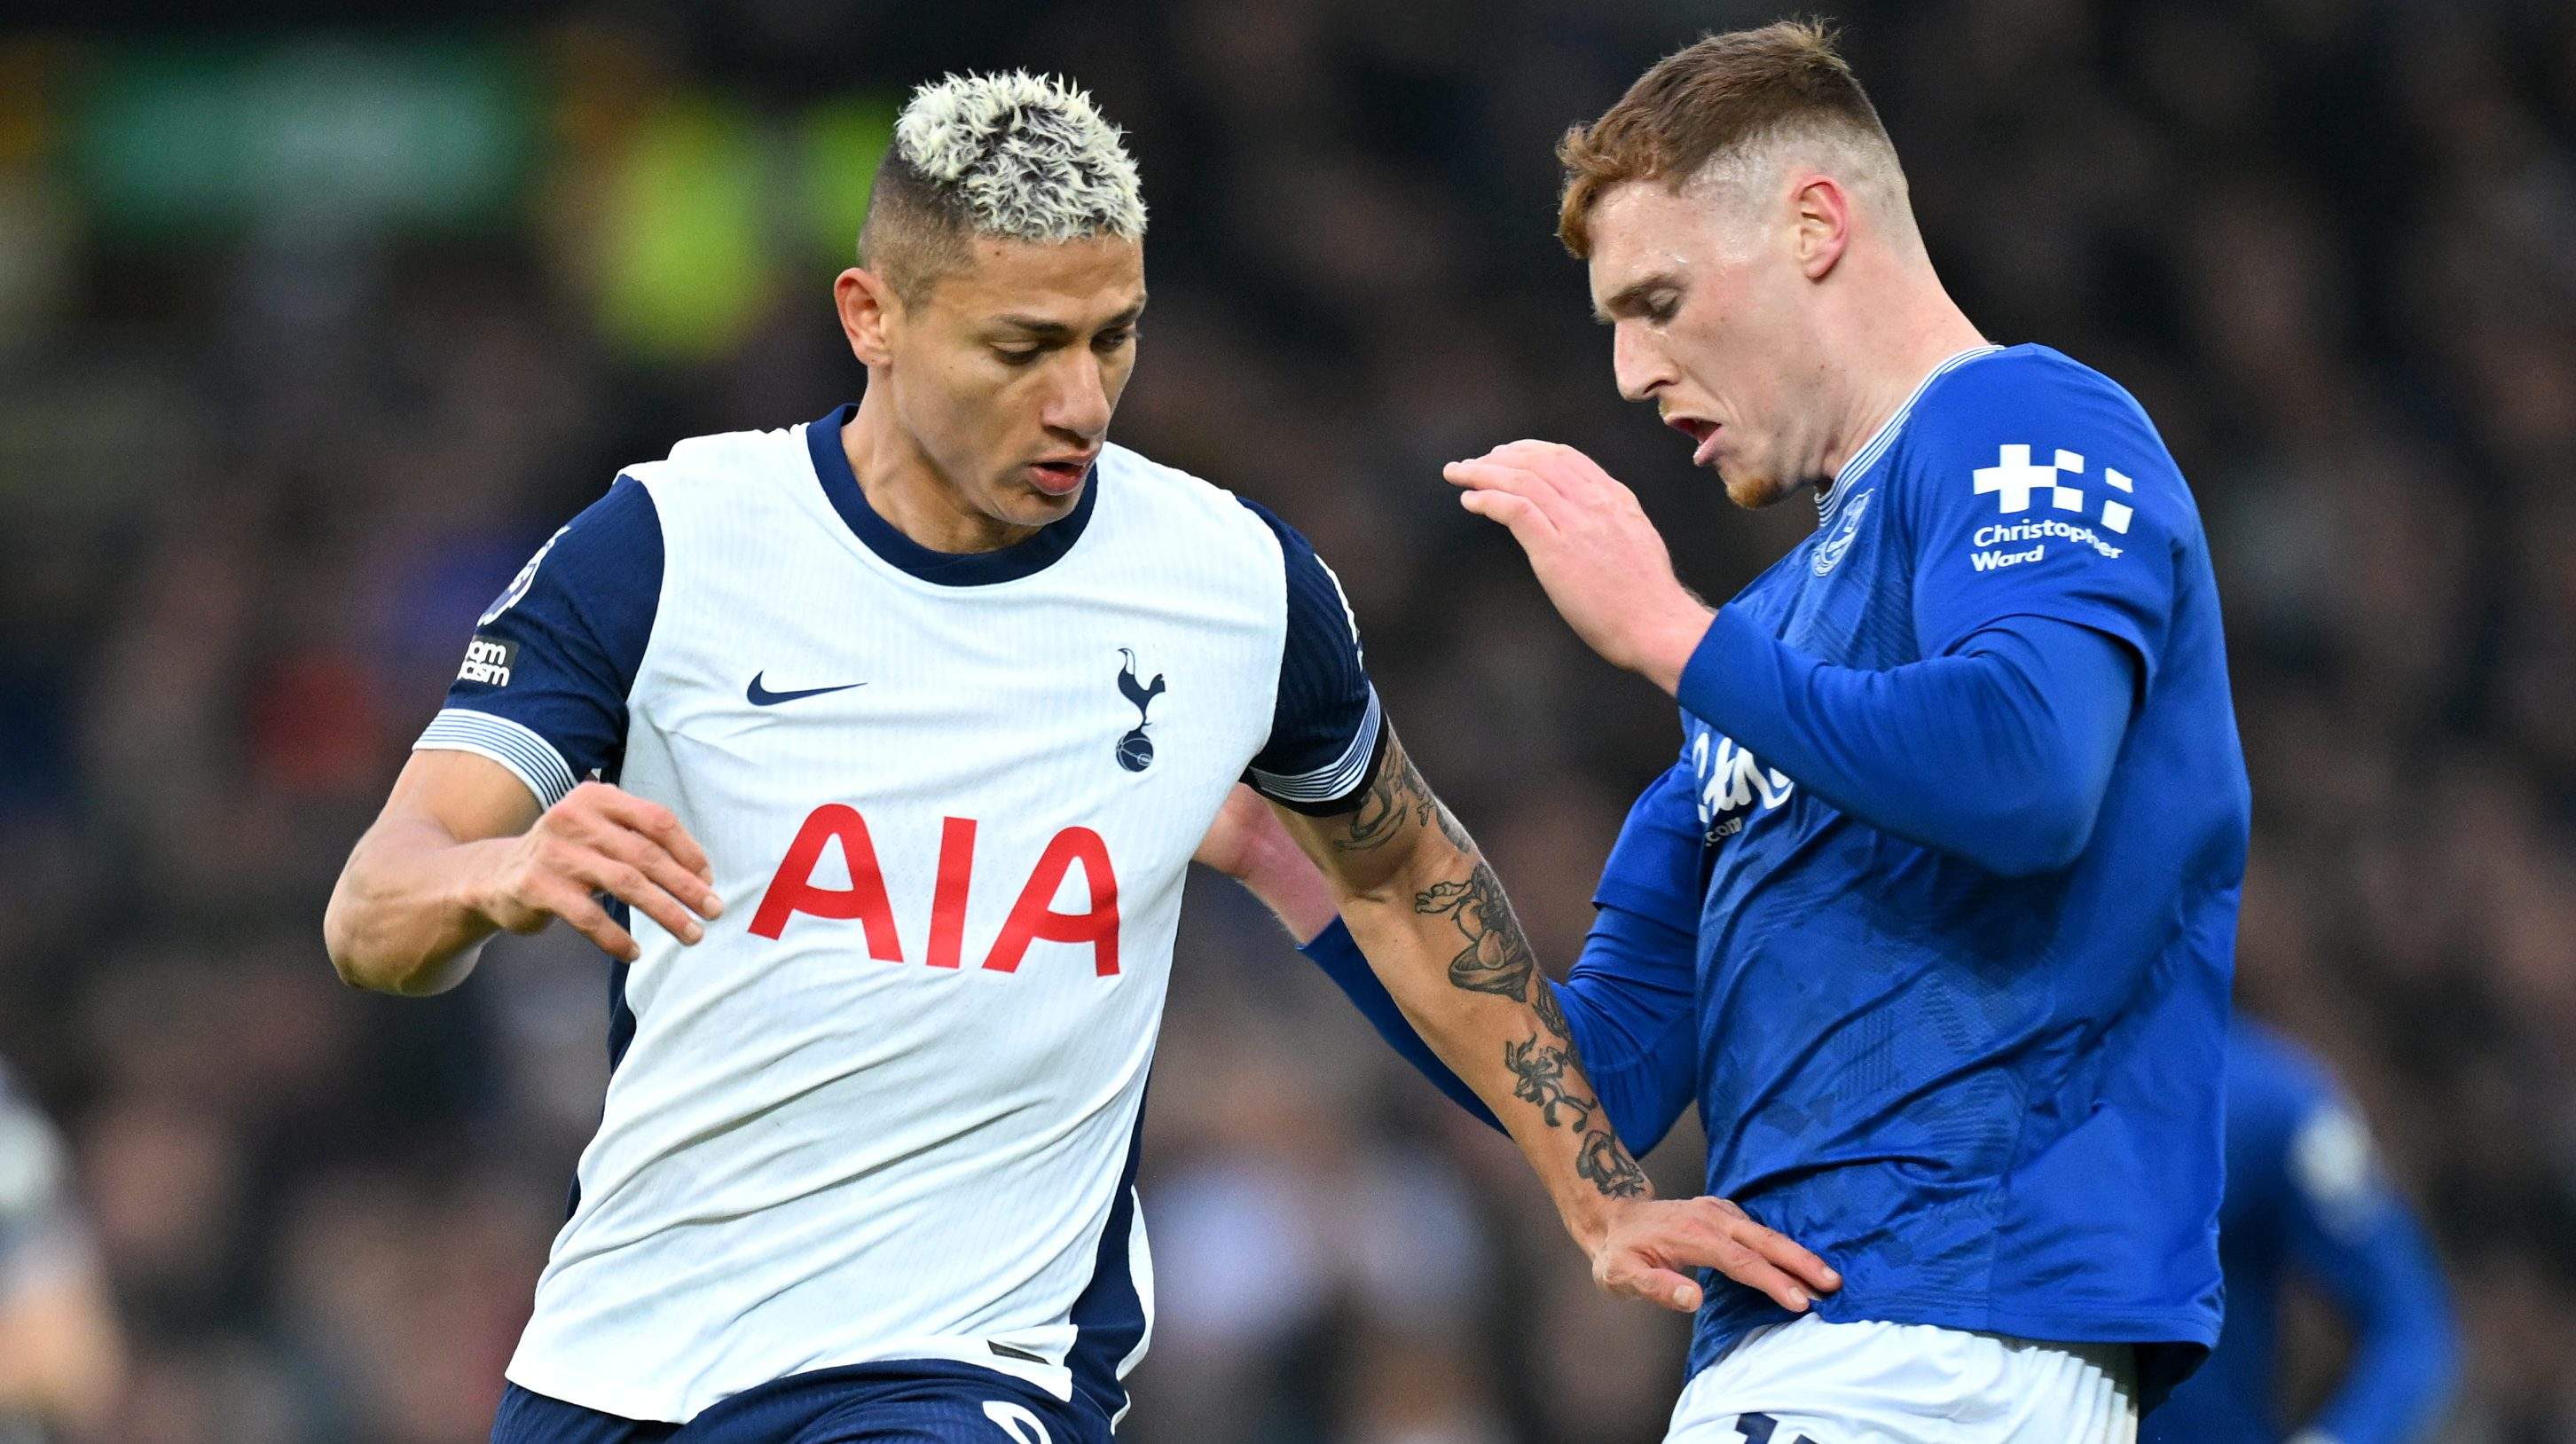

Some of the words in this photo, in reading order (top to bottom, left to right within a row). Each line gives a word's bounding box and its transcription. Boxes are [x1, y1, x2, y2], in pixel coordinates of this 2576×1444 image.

[1970, 544, 2045, 572] Ward
[1973, 518, 2124, 559] Christopher
[747, 803, 1121, 978] AIA
